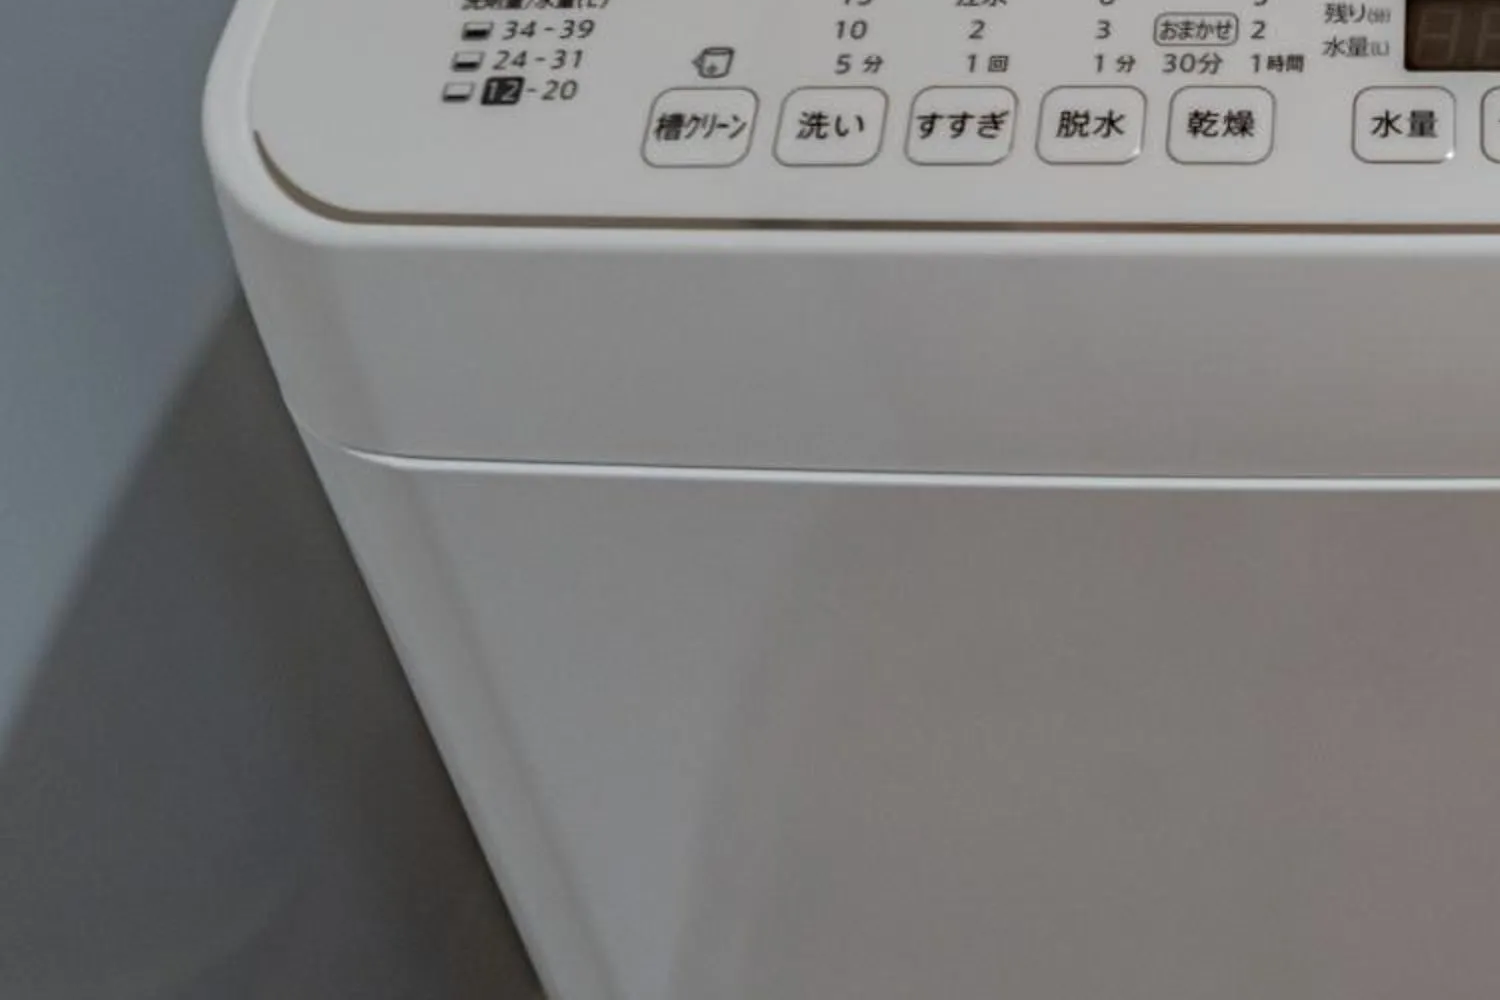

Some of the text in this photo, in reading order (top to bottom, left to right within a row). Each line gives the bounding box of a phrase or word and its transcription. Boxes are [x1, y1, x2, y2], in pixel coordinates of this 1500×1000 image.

[836, 19, 869, 41] 10
[968, 19, 986, 41] 2
[1095, 19, 1112, 40] 3
[1159, 20, 1234, 41] おまかせ
[1249, 19, 1267, 41] 2
[1161, 51, 1224, 76] 30分
[654, 111, 748, 142] 槽クリーン
[796, 111, 865, 140] 洗い
[916, 110, 1010, 140] すすぎ
[1055, 109, 1125, 139] 脱水
[1186, 109, 1255, 138] 乾燥
[1371, 109, 1437, 139] 水量
